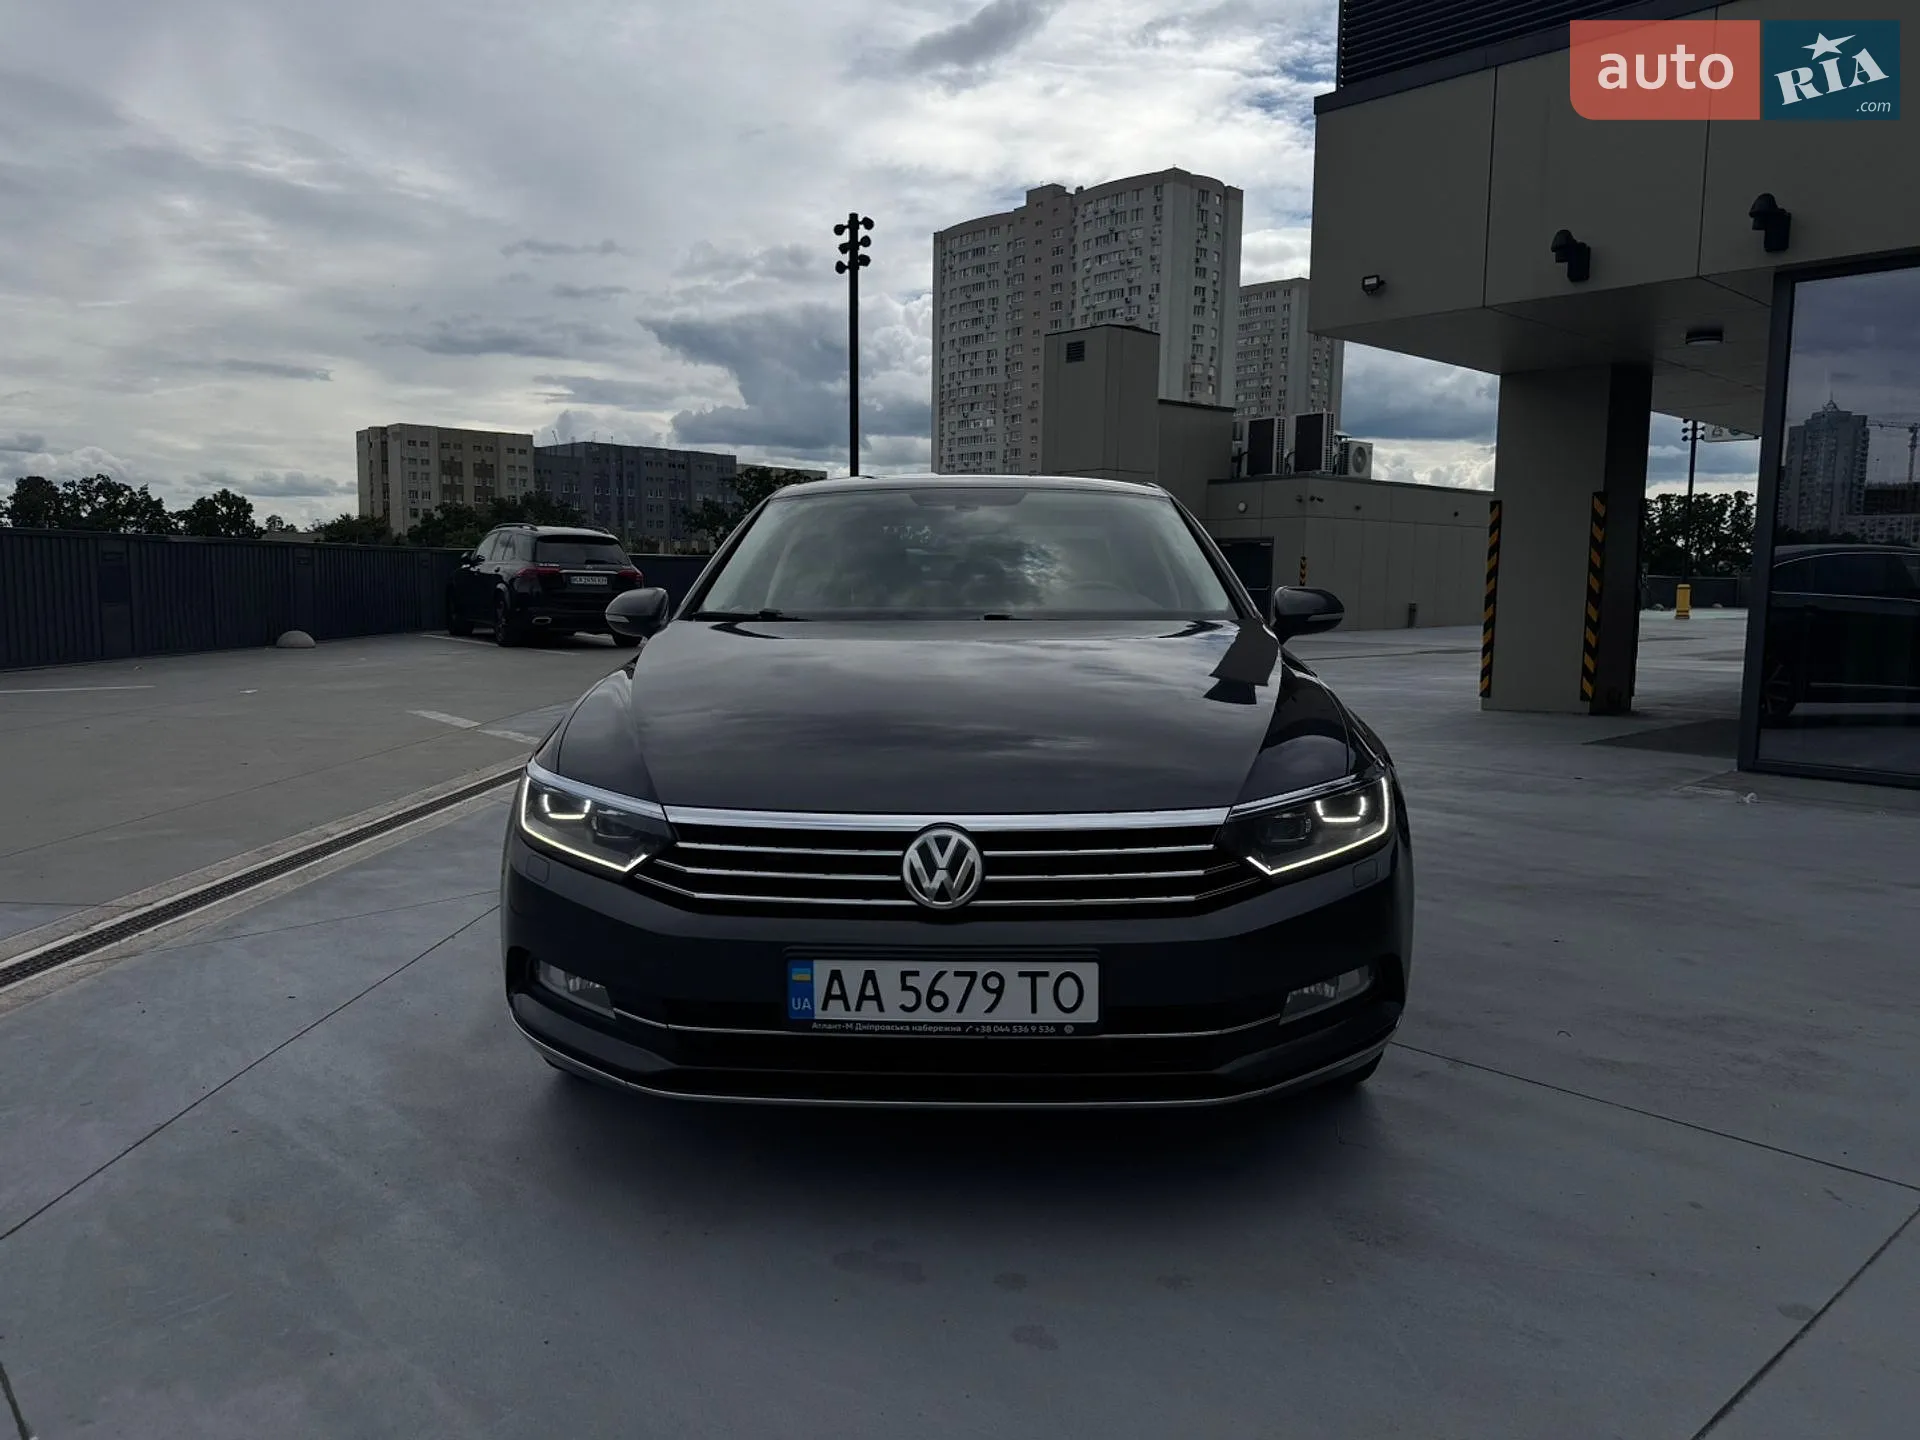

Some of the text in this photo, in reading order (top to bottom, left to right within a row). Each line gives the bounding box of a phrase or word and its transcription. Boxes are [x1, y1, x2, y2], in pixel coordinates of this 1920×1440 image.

[905, 830, 980, 908] VW
[791, 997, 812, 1011] UA
[821, 969, 1084, 1014] AA 5679 TO
